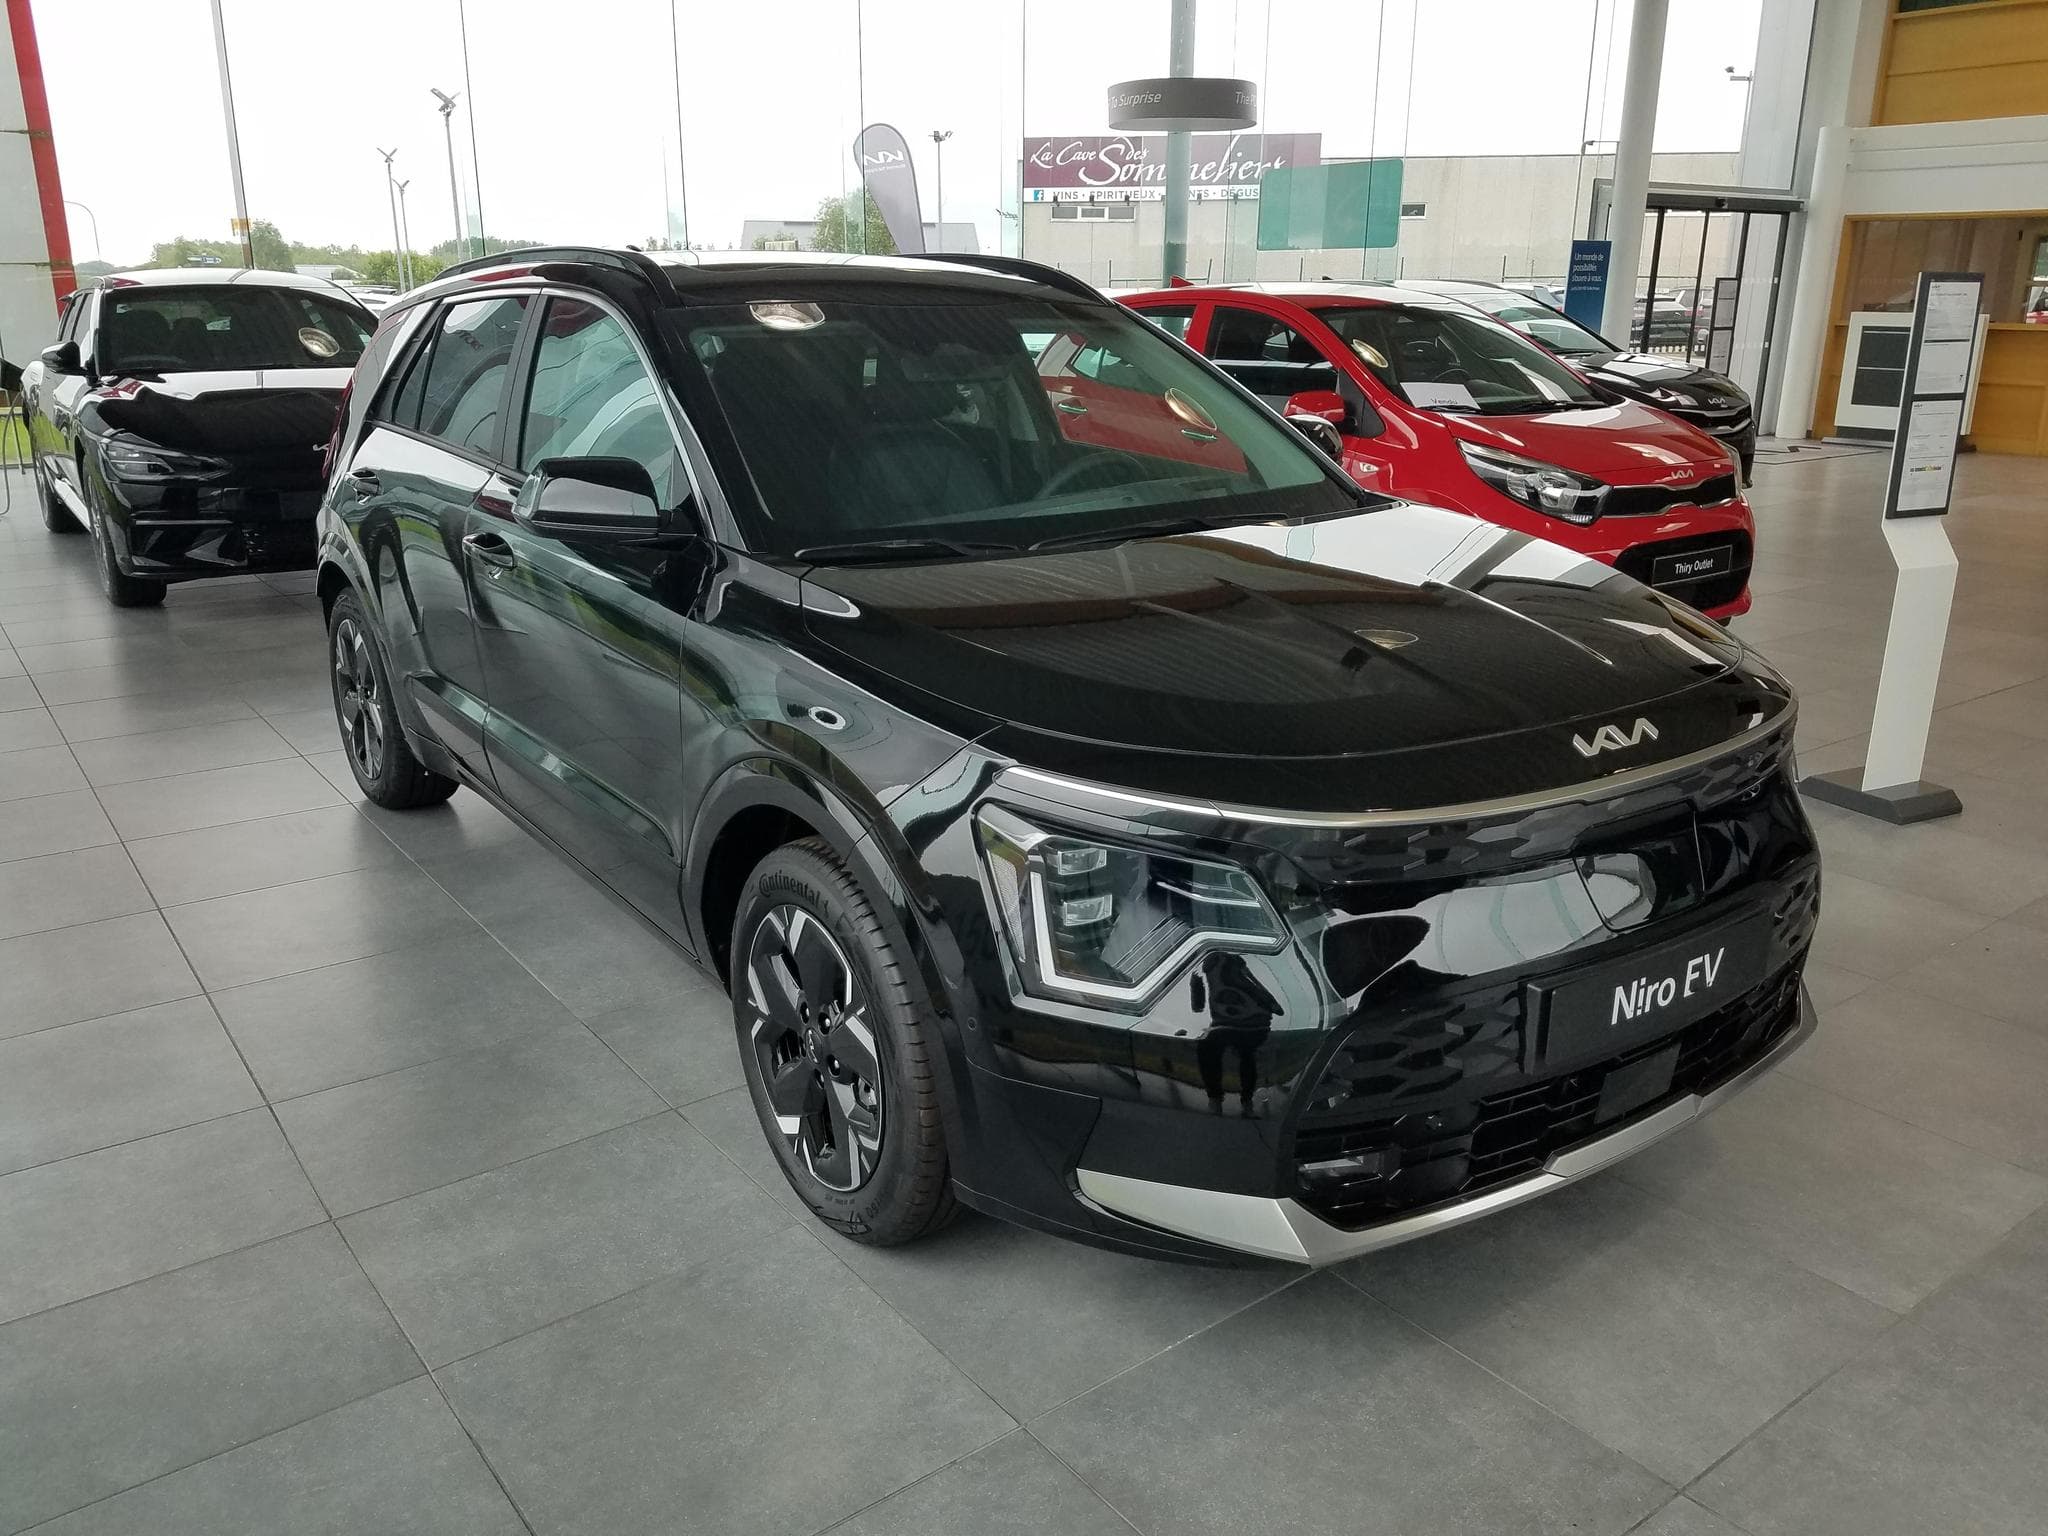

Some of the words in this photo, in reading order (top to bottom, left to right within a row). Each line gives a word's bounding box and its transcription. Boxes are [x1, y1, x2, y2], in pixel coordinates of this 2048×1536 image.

[1119, 91, 1162, 107] Surprise
[1235, 91, 1249, 104] The
[1030, 142, 1054, 168] La
[1056, 141, 1096, 165] Cave
[1113, 136, 1150, 160] des
[1053, 191, 1079, 200] VINS
[1582, 252, 1598, 260] monde
[1675, 562, 1693, 574] Thiry
[1694, 558, 1713, 571] Outlet
[1573, 718, 1660, 757] KIA
[758, 869, 821, 909] Continental
[1610, 976, 1676, 1026] Niro
[1683, 947, 1725, 998] EV
